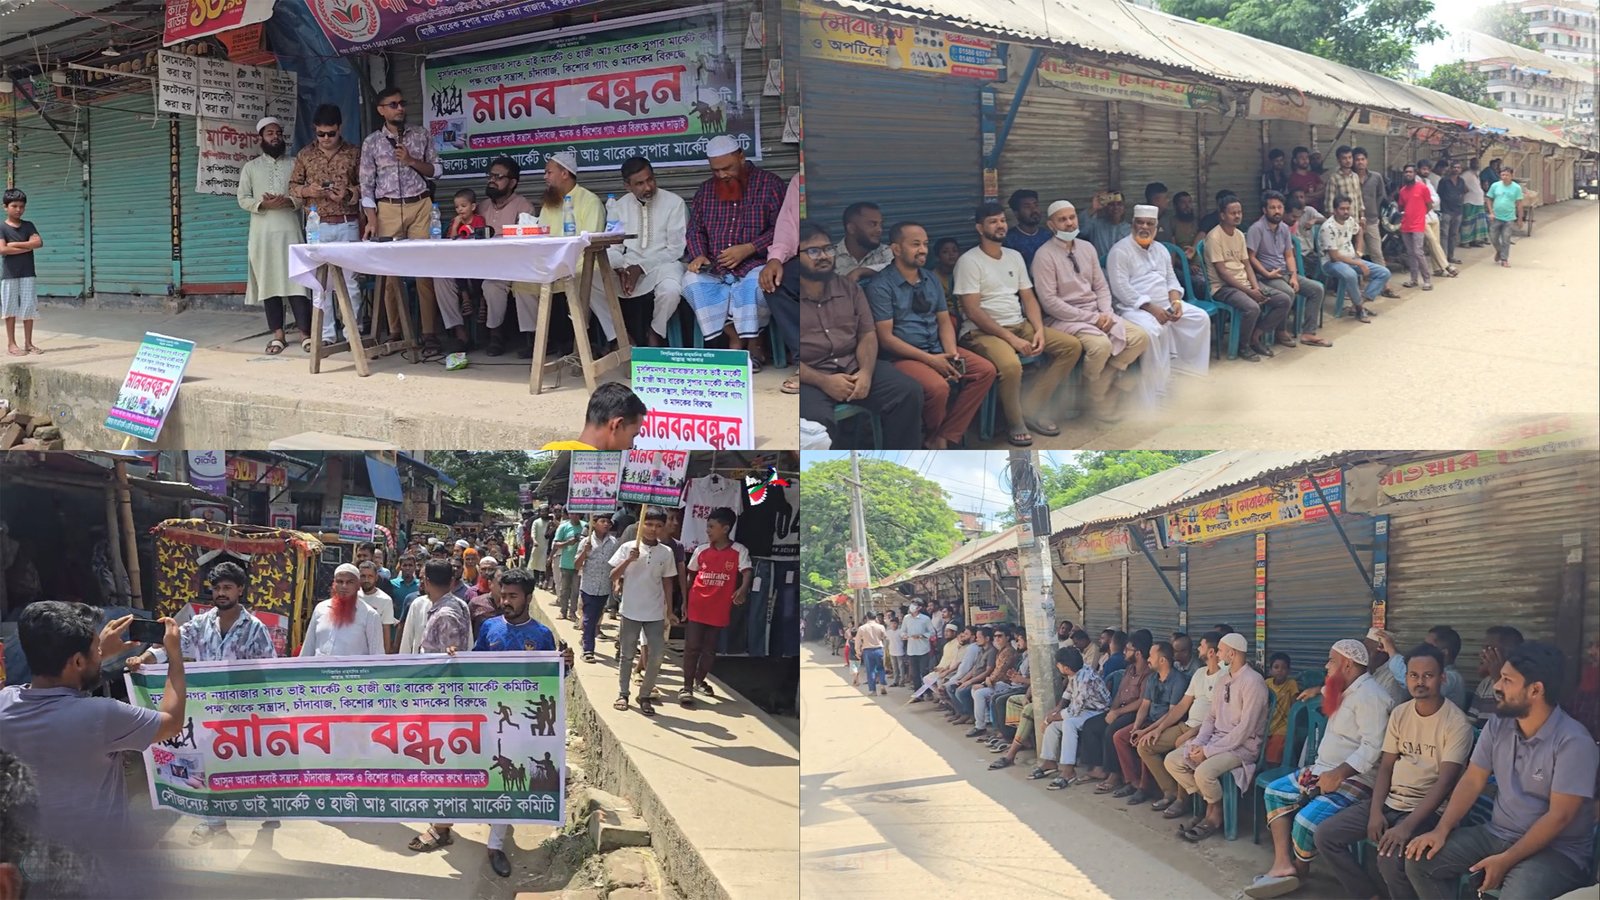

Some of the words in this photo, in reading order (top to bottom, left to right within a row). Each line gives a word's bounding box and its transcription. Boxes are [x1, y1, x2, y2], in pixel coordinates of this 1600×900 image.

[438, 20, 460, 32] বারেক
[461, 17, 480, 28] সুপার
[483, 12, 505, 23] মার্কেট
[507, 60, 521, 69] সাত
[525, 56, 538, 66] ভাই
[541, 51, 563, 63] মার্কেট
[576, 46, 594, 60] হাজী
[614, 42, 639, 53] বারেক
[642, 37, 664, 51] সুপার
[668, 32, 696, 46] মার্কেট
[166, 67, 180, 78] করা
[182, 70, 192, 81] হয়
[484, 76, 502, 85] থেকে
[562, 62, 589, 74] কিশোর
[592, 58, 609, 70] গ্যাং
[612, 59, 619, 67] ও
[621, 54, 653, 66] মাদকের
[656, 49, 686, 62] বিরুদ্ধে
[162, 83, 195, 97] ফটোকপি
[467, 79, 556, 124] মানব
[587, 64, 687, 117] বন্ধন
[164, 100, 179, 110] করা
[181, 101, 192, 111] হয়
[205, 103, 218, 113] করা
[220, 105, 229, 115] হয়
[582, 125, 602, 137] কিশোর
[470, 156, 489, 169] সাত
[580, 148, 600, 162] আঃ
[603, 145, 636, 160] বারেক
[640, 143, 670, 161] সুপার
[674, 136, 709, 154] মার্কেট
[646, 386, 660, 394] থেকে
[707, 388, 728, 398] কিশোর
[668, 377, 685, 385] বারেক
[687, 378, 702, 387] সুপার
[704, 377, 722, 387] মার্কেট
[150, 691, 207, 706] মুসনগর
[211, 688, 259, 700] নয়াবাজার
[263, 687, 283, 698] সাত
[287, 683, 307, 697] ভাই
[309, 682, 341, 695] মার্কেট
[345, 685, 353, 694] ও
[356, 681, 379, 695] হাজী
[384, 682, 400, 693] আঃ
[404, 682, 434, 693] বারেক
[437, 681, 464, 695] সুপার
[468, 679, 499, 693] মার্কেট
[502, 679, 539, 693] কমিটির
[205, 703, 224, 715] পক্ষ
[228, 703, 254, 714] থেকে
[258, 701, 289, 714] সন্ত্রাস,
[293, 699, 337, 712] চাঁদাবাজ,
[340, 696, 374, 709] কিশোর
[378, 697, 397, 710] গ্যাং
[401, 699, 408, 708] ও
[413, 696, 450, 709] মাদকের
[454, 695, 488, 709] বিরুদ্ধে
[203, 713, 331, 760] মানব
[371, 713, 488, 765] বন্ধন
[213, 776, 234, 789] আসুন
[235, 775, 257, 786] আমরা
[259, 772, 277, 784] সবাই
[279, 773, 301, 785] সন্ত্রাস,
[303, 770, 334, 785] চাঁদাবাজ,
[336, 773, 353, 783] মাদক
[357, 774, 363, 782] ও
[365, 770, 389, 783] কিশোর
[391, 773, 406, 784] গ্যাং
[407, 773, 419, 783] এর
[420, 770, 445, 784] বিরুদ্ধে
[446, 773, 463, 783] রুখে
[161, 788, 209, 811] সৌজন্যেঃ
[213, 799, 238, 812] সাত
[243, 794, 267, 813] ভাই
[271, 791, 309, 811] মার্কেট
[314, 799, 325, 810] ও
[330, 792, 359, 813] হাজী
[363, 798, 386, 814] আঃ
[391, 798, 429, 813] বারেক
[433, 799, 467, 816] সুপার
[472, 794, 512, 813] মার্কেট
[517, 794, 556, 814] কমিটি
